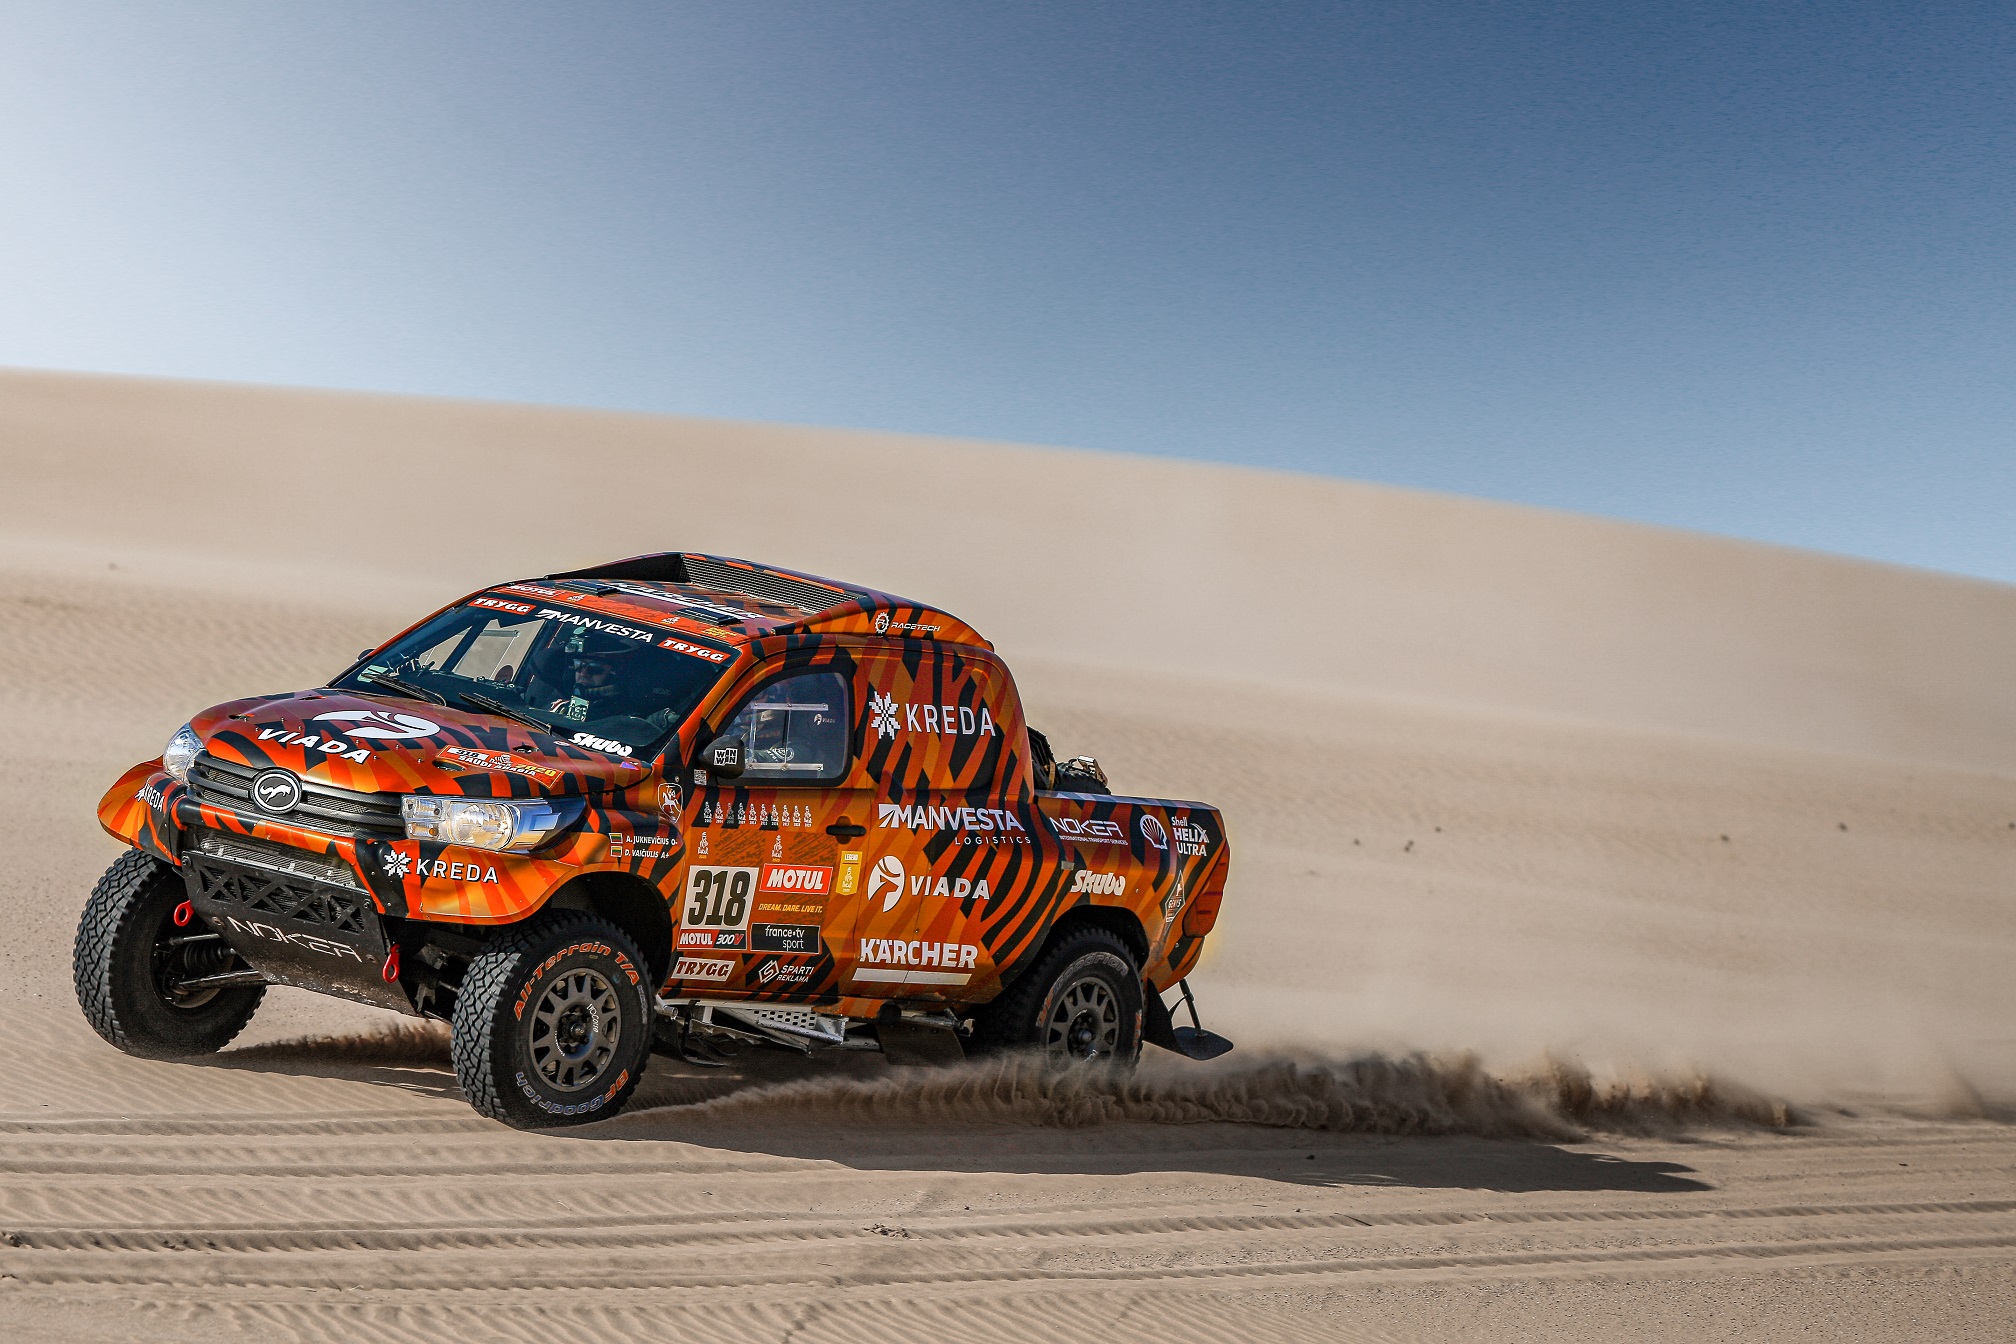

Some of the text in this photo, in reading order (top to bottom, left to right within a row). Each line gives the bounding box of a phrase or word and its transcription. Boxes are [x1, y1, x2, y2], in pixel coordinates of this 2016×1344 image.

[473, 597, 531, 614] TRYGG
[552, 610, 654, 643] MANVESTA
[890, 621, 941, 632] RACETECH
[665, 638, 725, 662] TRYGG
[905, 703, 996, 737] KREDA
[257, 728, 371, 764] VIADA
[898, 804, 1025, 832] MANVESTA
[1171, 816, 1188, 827] Shell
[954, 836, 1031, 846] LOGISTICS
[1173, 827, 1209, 843] HELIX
[1176, 843, 1207, 857] ULTRA
[416, 858, 499, 884] KREDA
[766, 868, 824, 890] MOTUL
[910, 875, 990, 900] VIADA
[687, 869, 750, 926] 318
[758, 903, 782, 911] DREAM.
[782, 904, 801, 912] DARE.
[679, 933, 744, 945] MOTUL 300V
[782, 939, 804, 952] sport
[859, 938, 978, 969] KÄRCHER
[676, 961, 730, 977] TRYGG
[780, 964, 815, 975] SPARTI
[776, 974, 809, 983] REKLAMA
